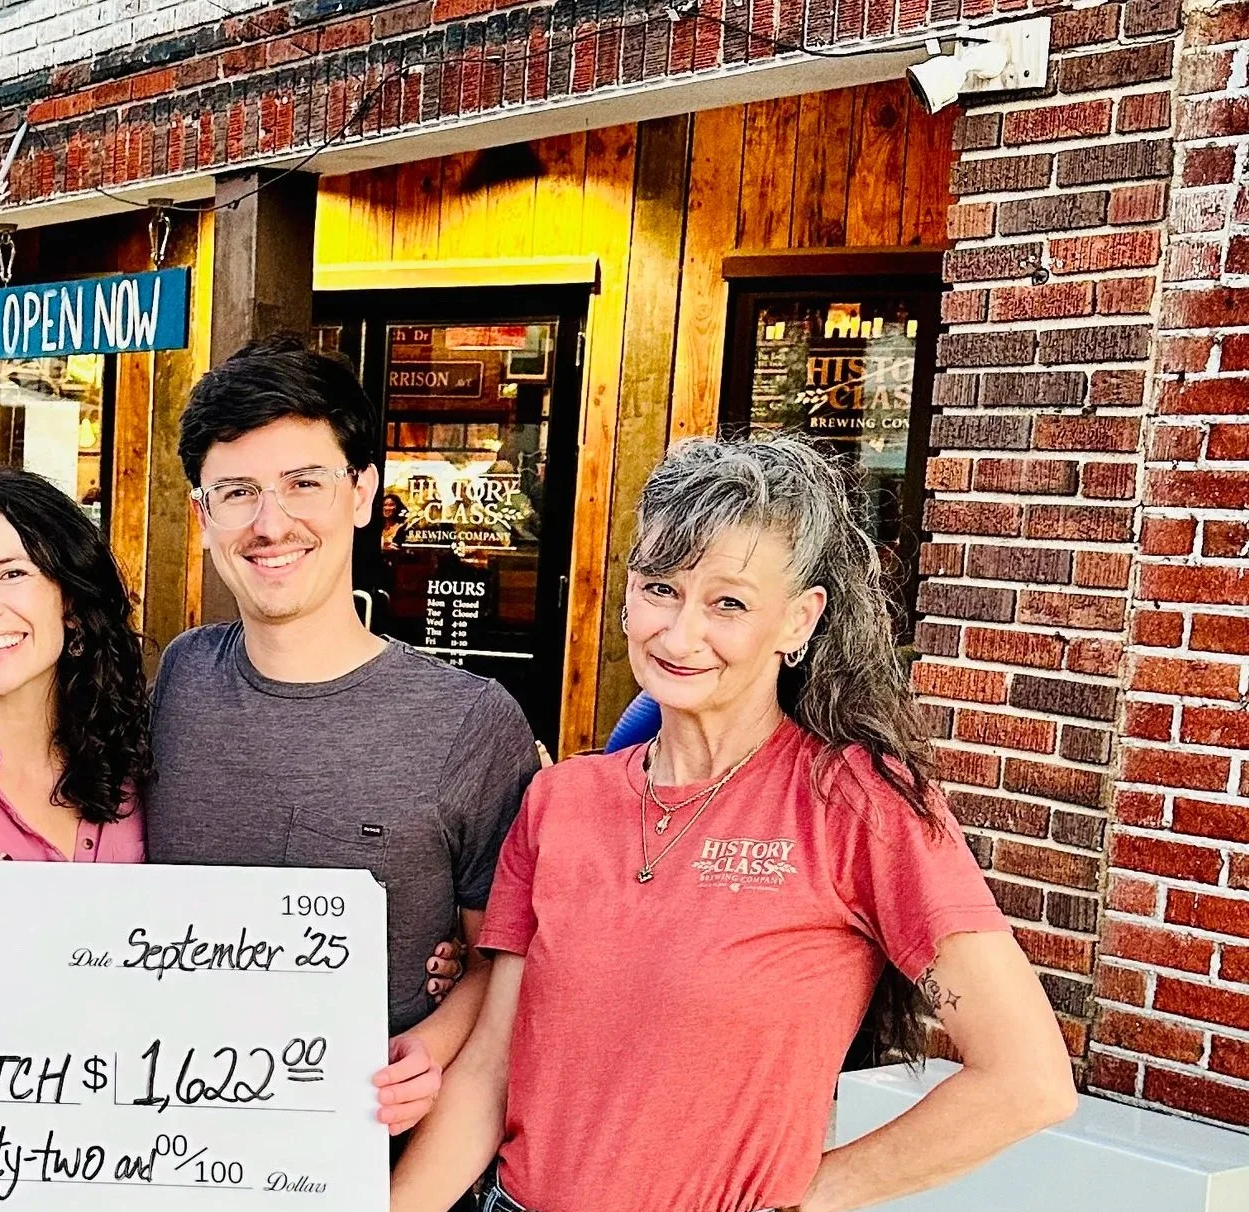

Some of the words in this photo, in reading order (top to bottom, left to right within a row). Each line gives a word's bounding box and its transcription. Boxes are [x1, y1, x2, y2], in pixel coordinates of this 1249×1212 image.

[2, 285, 84, 354] OPEN
[93, 276, 161, 350] NOW
[414, 330, 429, 341] Dr
[810, 417, 876, 429] BREWING
[423, 502, 499, 525] CLASS
[408, 529, 457, 541] BREWING
[427, 580, 486, 596] HOURS
[427, 598, 445, 608] Mon
[452, 599, 480, 609] Closed
[426, 608, 442, 617] Tue
[451, 609, 479, 619] Closed
[426, 617, 444, 627] Wed
[425, 636, 437, 645] Fri
[701, 839, 795, 861] HISTORY
[713, 857, 774, 875] CLASS
[280, 894, 346, 918] 1909
[67, 948, 114, 968] Date
[122, 923, 285, 981] September
[83, 1055, 108, 1092] $
[114, 1148, 158, 1183] and
[263, 1171, 328, 1194] Dollars
